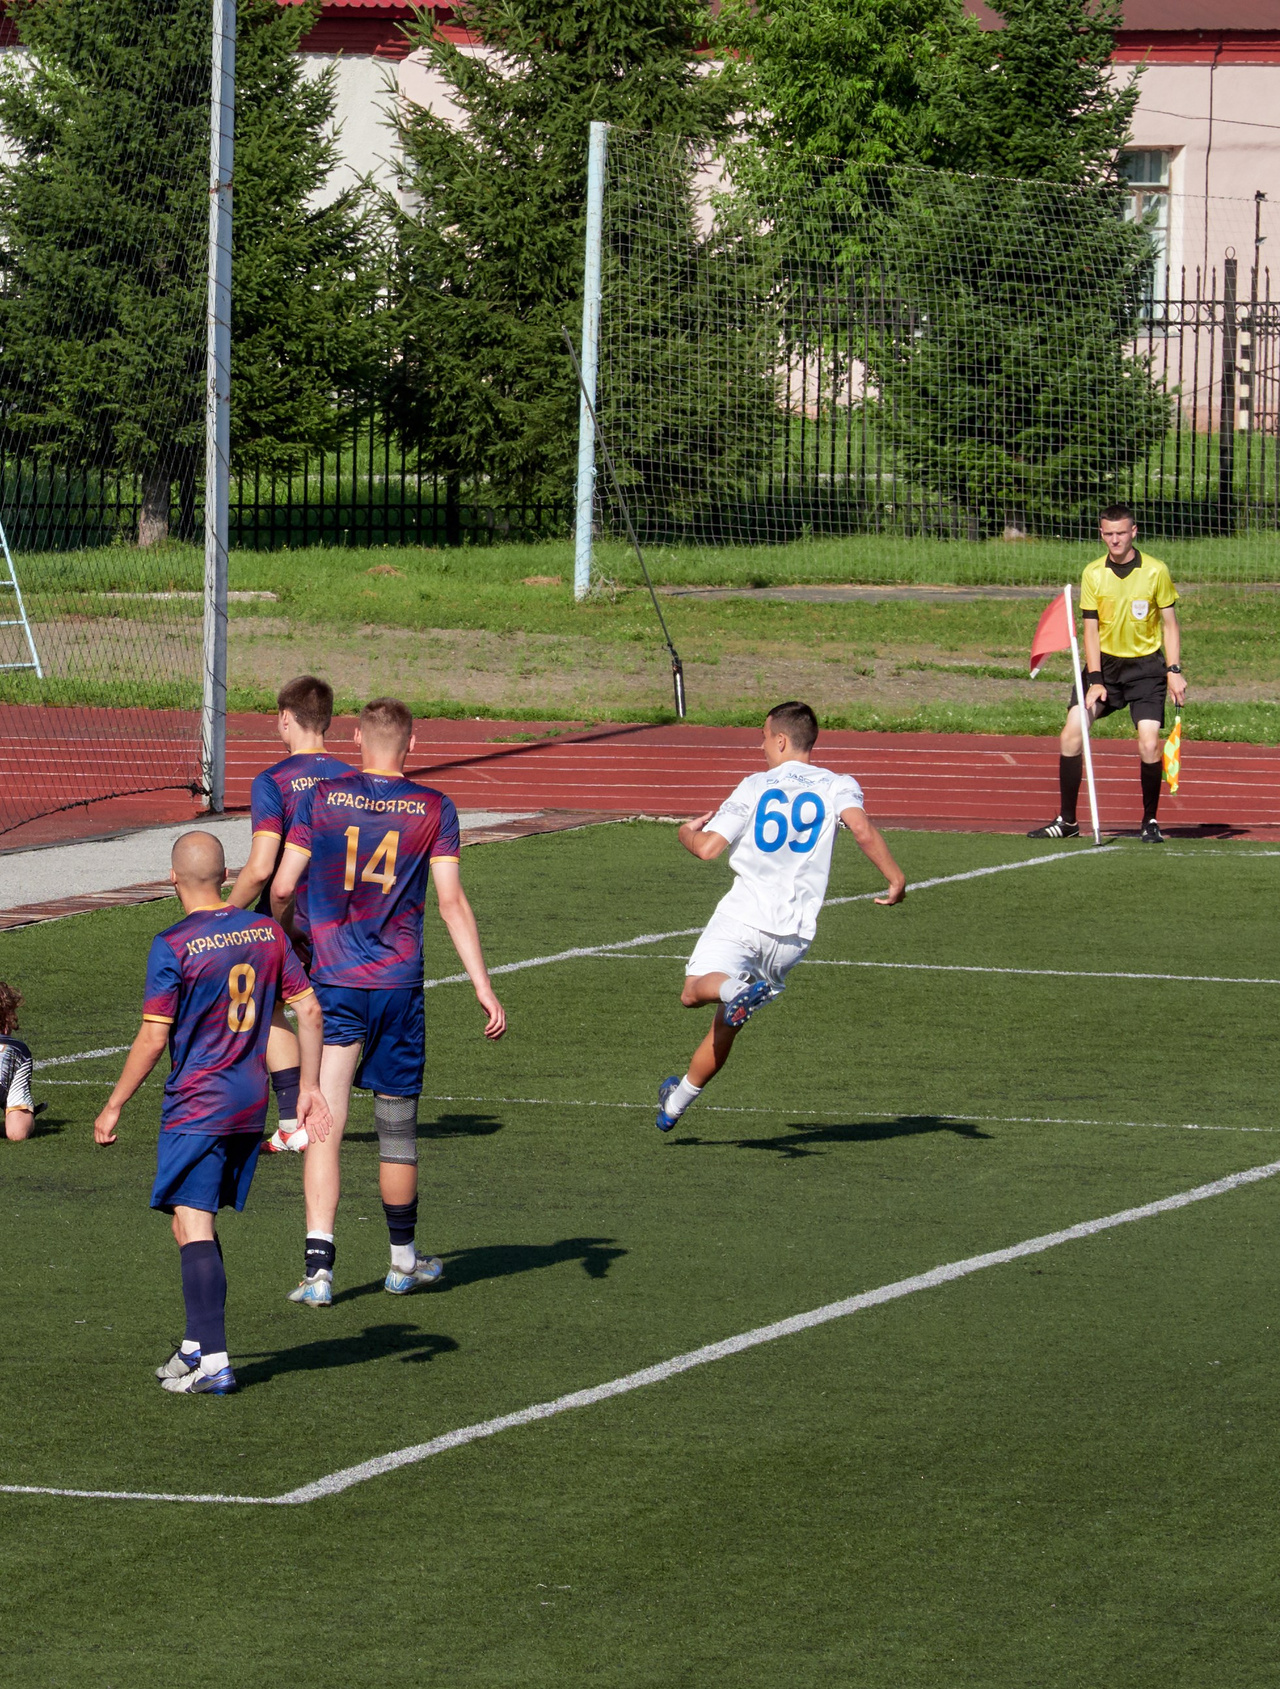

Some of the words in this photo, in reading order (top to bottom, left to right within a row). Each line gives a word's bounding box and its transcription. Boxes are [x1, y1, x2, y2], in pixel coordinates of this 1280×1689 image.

[326, 792, 426, 815] КРАСНОЯРСК
[754, 788, 826, 853] 69
[344, 826, 400, 894] 14
[186, 927, 276, 956] КРАСНОЯРСК
[227, 963, 256, 1033] 8
